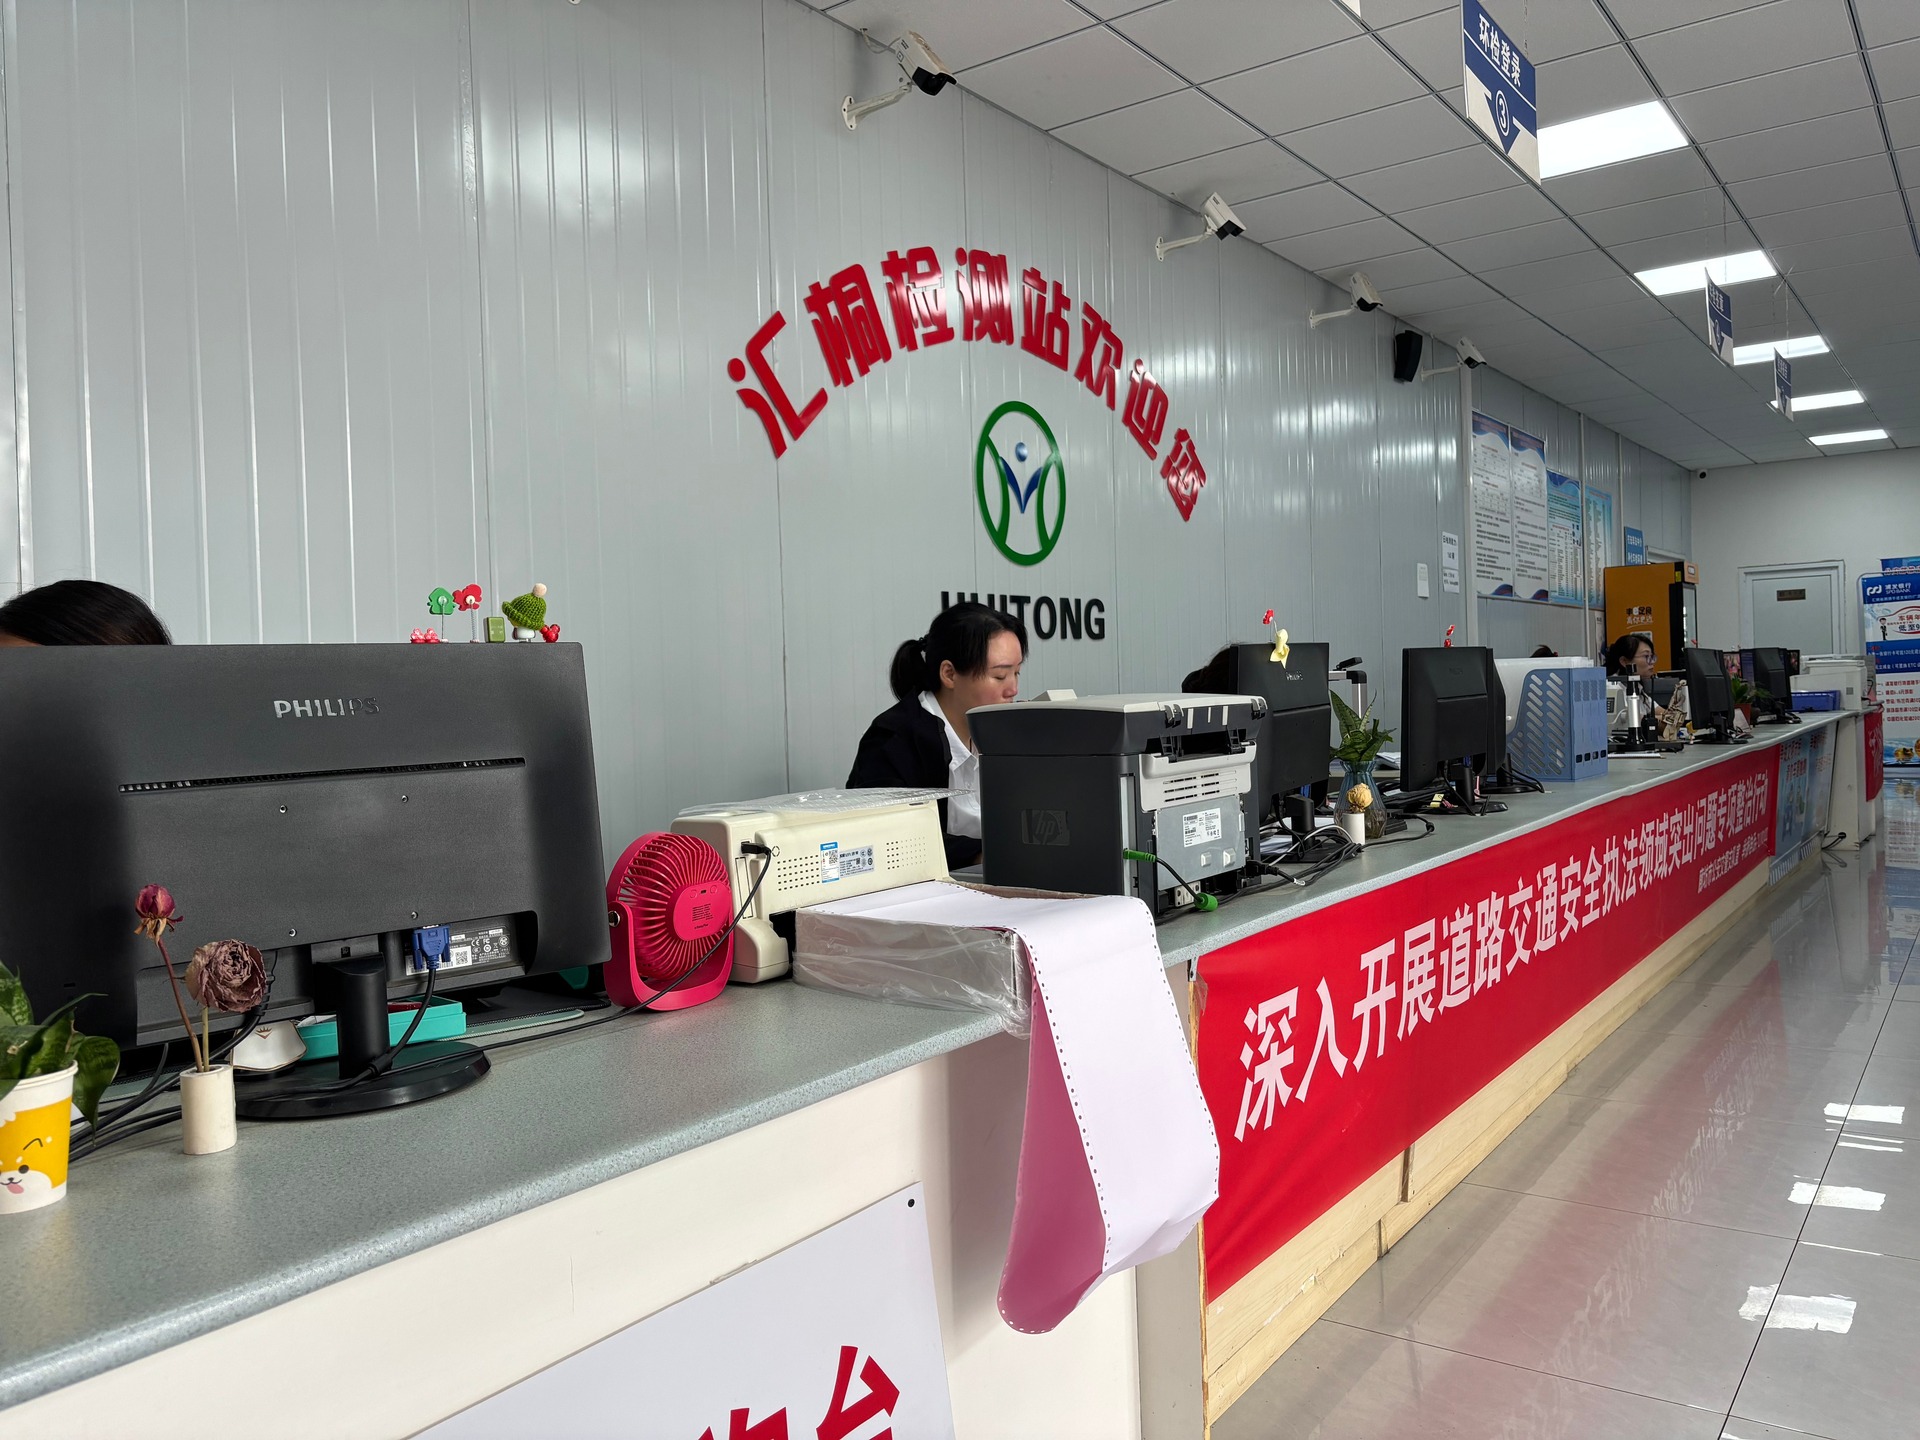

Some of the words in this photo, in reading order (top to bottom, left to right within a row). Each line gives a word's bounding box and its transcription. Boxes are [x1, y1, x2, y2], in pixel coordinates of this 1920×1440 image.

[1478, 13, 1521, 87] 环检登录
[727, 246, 1206, 522] 汇桐检测站欢迎您
[273, 698, 379, 718] PHILIPS
[1234, 769, 1768, 1142] 深入开展道路交通安全执法领域突出问题专项整治行动
